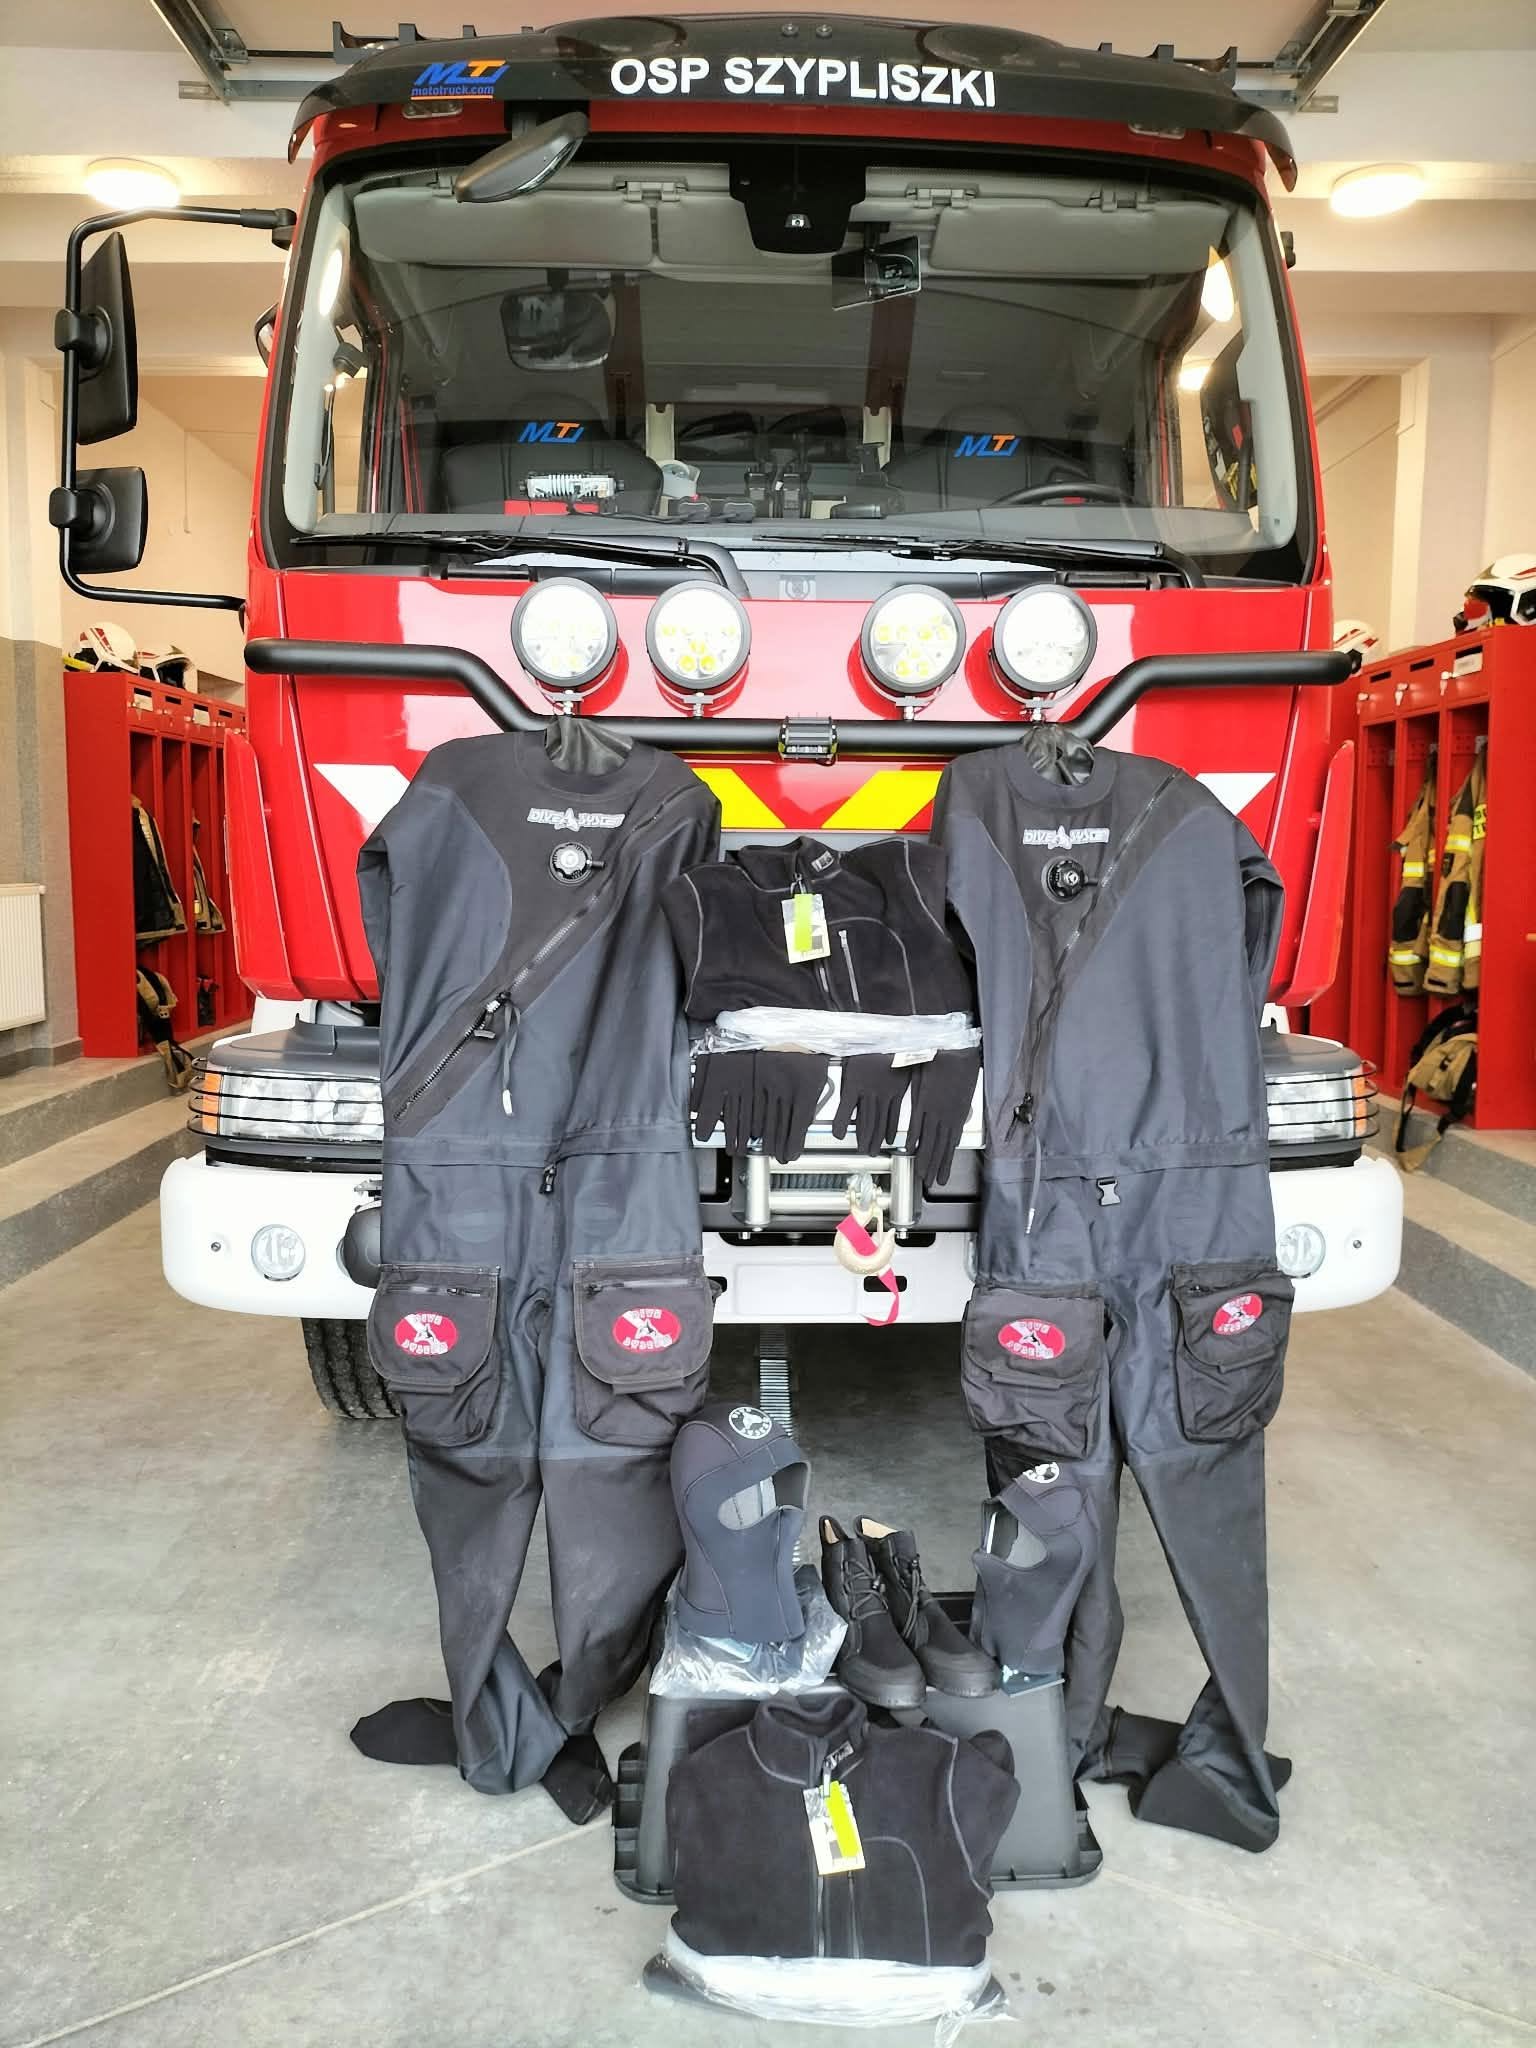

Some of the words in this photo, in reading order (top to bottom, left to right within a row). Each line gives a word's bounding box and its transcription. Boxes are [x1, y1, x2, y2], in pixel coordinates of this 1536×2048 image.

[411, 85, 494, 96] mototruck.com
[610, 57, 710, 94] OSP
[723, 57, 996, 107] SZYPLISZKI
